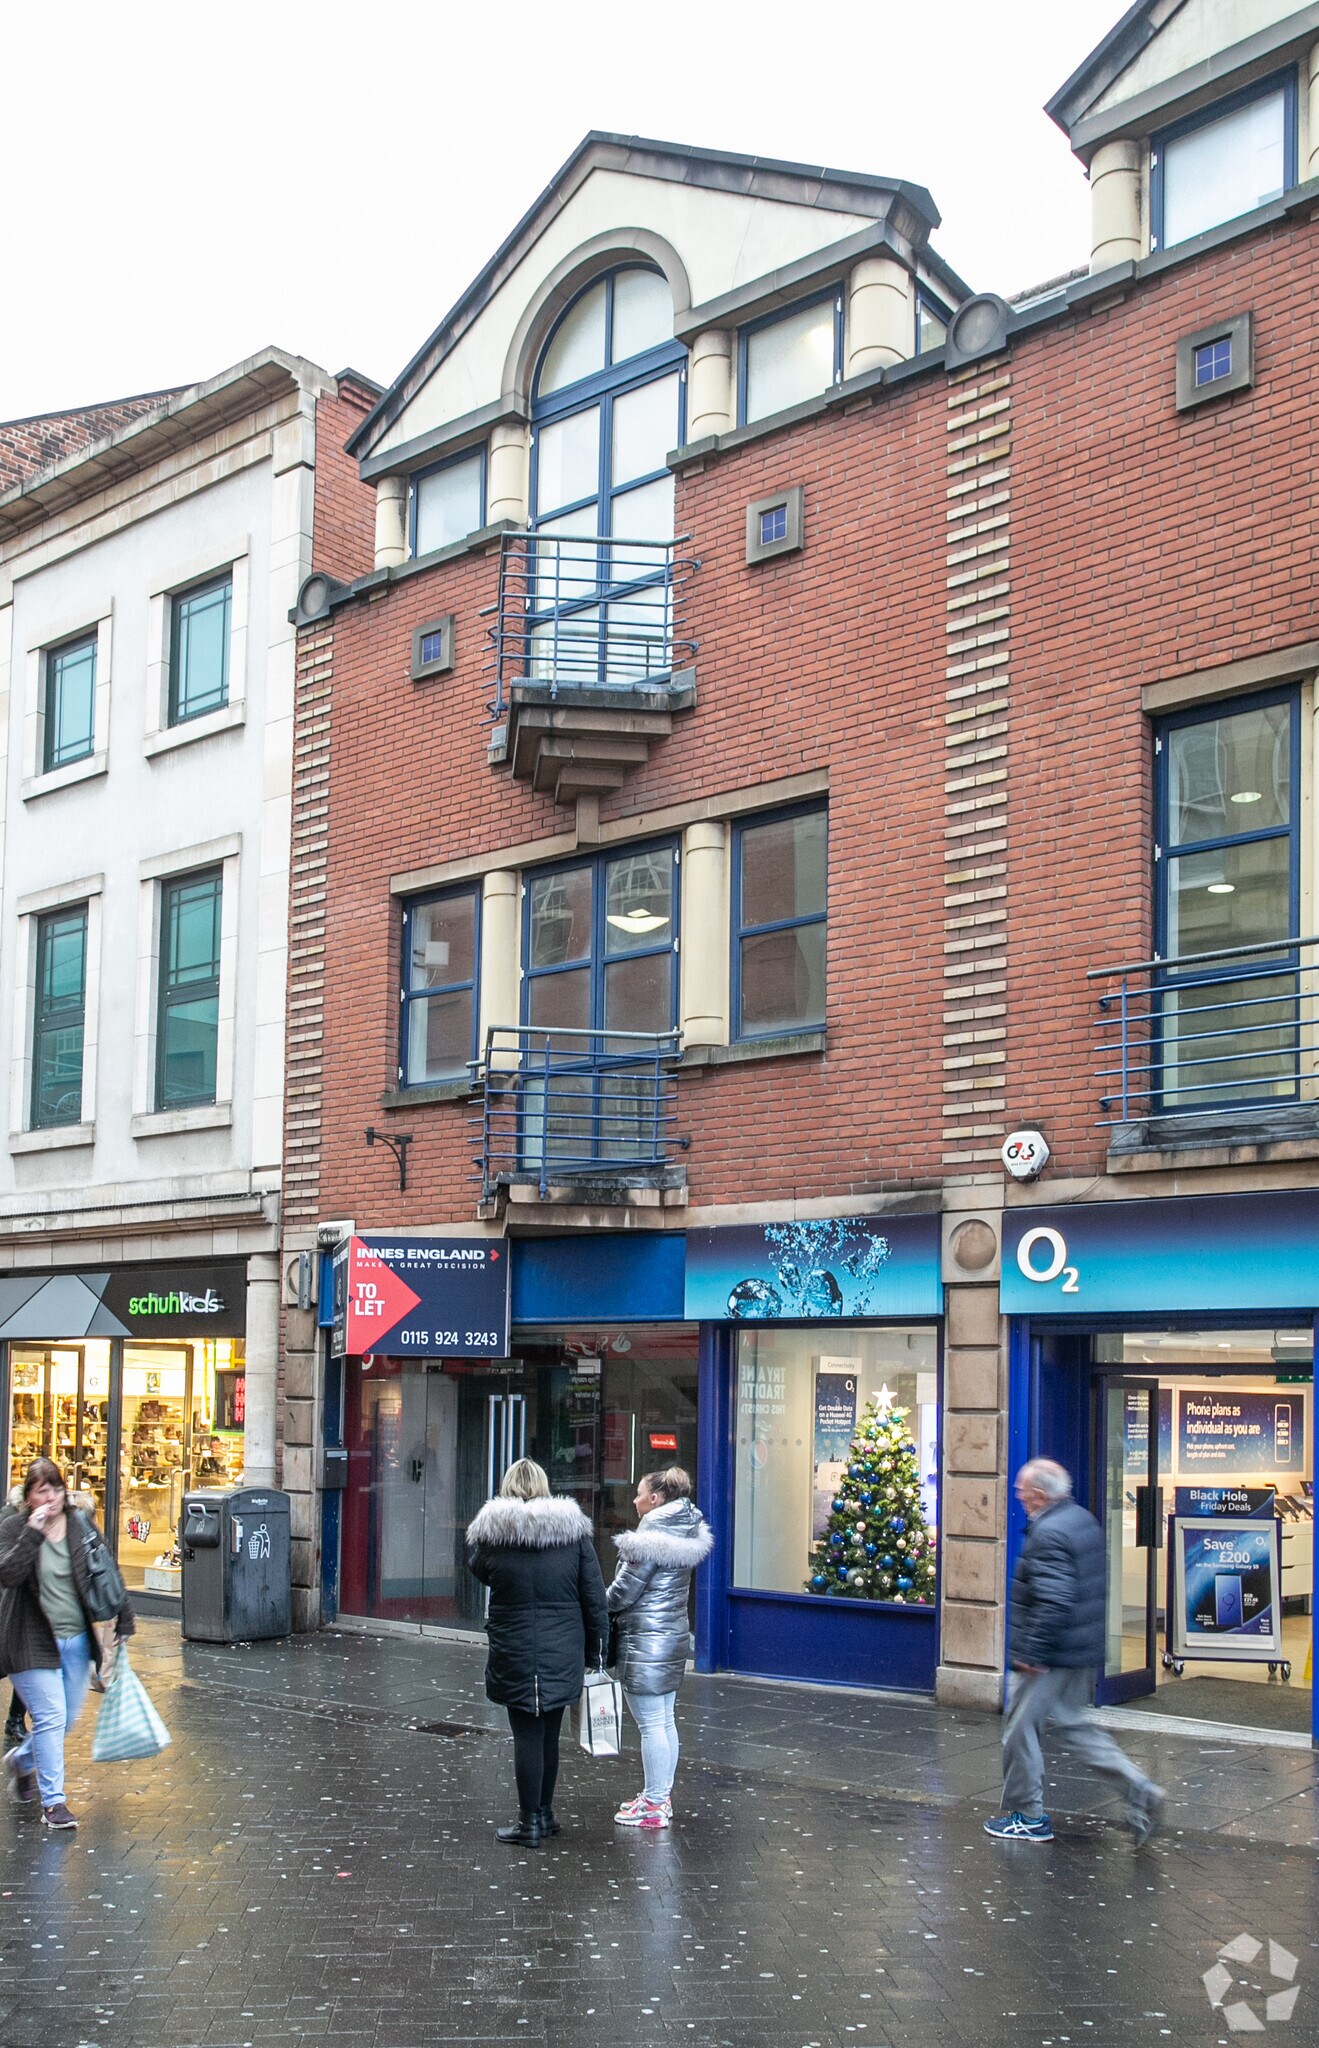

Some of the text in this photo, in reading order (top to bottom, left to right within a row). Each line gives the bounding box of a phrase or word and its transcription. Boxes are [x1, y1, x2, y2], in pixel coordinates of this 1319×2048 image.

[356, 1248, 405, 1259] INNES
[407, 1249, 485, 1260] ENGLAND
[1017, 1227, 1079, 1293] O2
[355, 1283, 377, 1298] TO
[355, 1300, 385, 1316] LET
[401, 1331, 498, 1346] 0115 924 3243
[827, 1361, 855, 1369] Connectivity
[845, 1379, 855, 1393] O2
[1186, 1402, 1241, 1419] Phone plans as
[1186, 1421, 1260, 1437] individual as you are
[1190, 1490, 1248, 1501] Black Hole
[1200, 1502, 1252, 1512] Friday Deals
[1203, 1538, 1234, 1550] Save
[1219, 1551, 1250, 1564] £200
